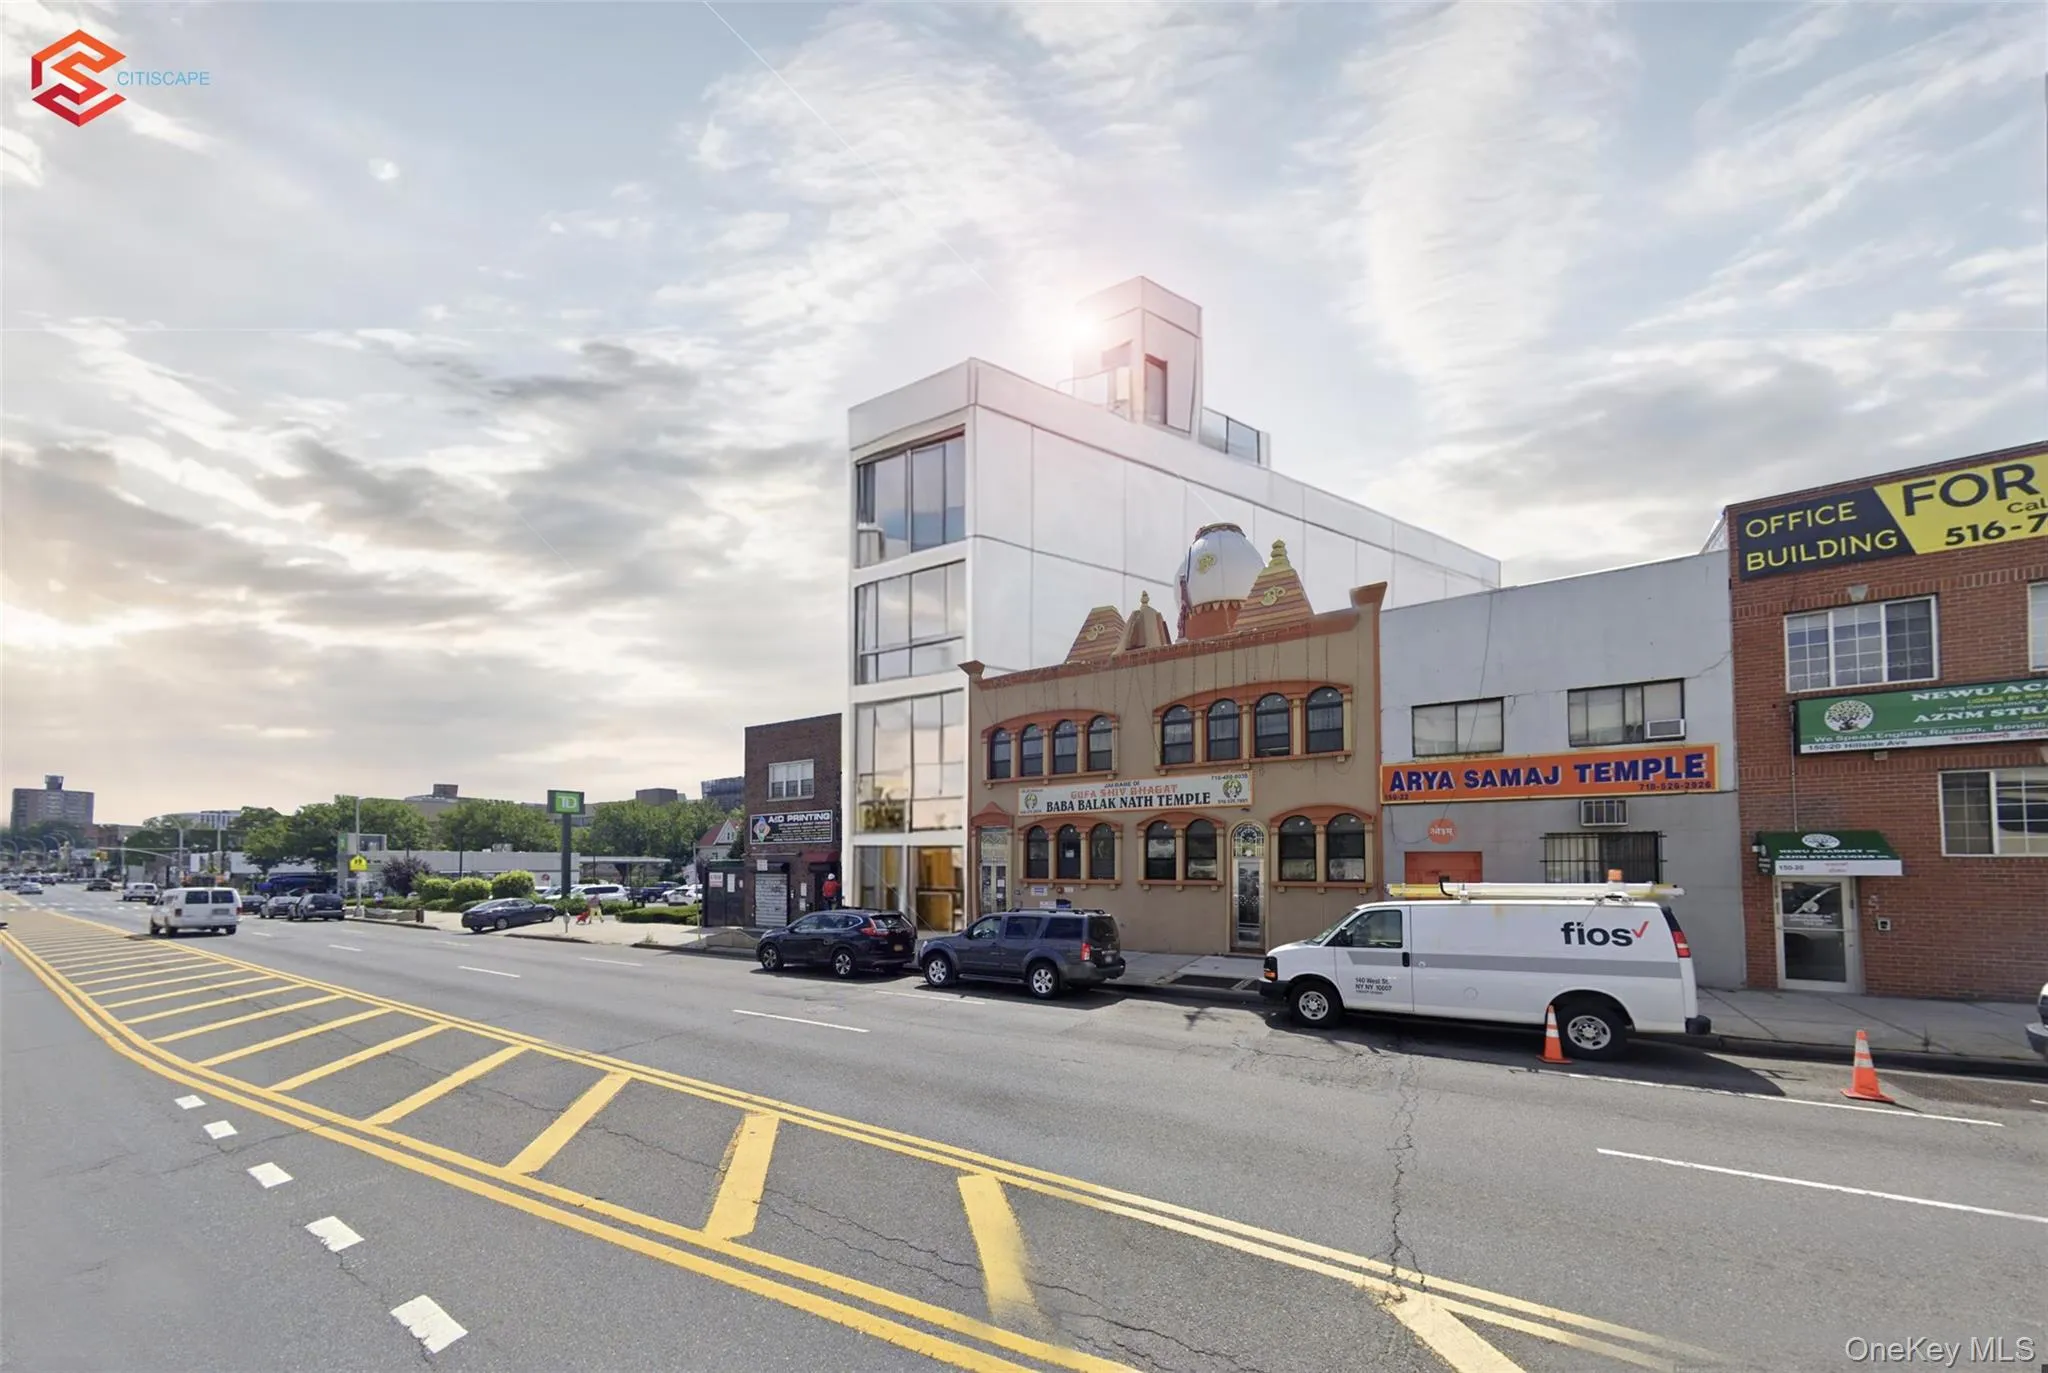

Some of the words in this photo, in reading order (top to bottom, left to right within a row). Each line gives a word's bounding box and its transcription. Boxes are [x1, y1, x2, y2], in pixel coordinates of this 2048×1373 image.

[1902, 463, 2041, 517] FOR
[1745, 501, 1858, 538] OFFICE
[1746, 529, 1898, 572] BUILDING
[1390, 770, 1456, 792] ARYA
[1463, 764, 1562, 789] SAMAJ
[1573, 752, 1708, 784] TEMPLE
[561, 796, 577, 809] TD
[787, 812, 831, 823] PRINTING
[1046, 800, 1075, 813] BABA
[1078, 797, 1117, 812] BALAK
[1120, 794, 1153, 809] NATH
[1157, 792, 1211, 807] TEMPLE
[1561, 921, 1633, 947] fios
